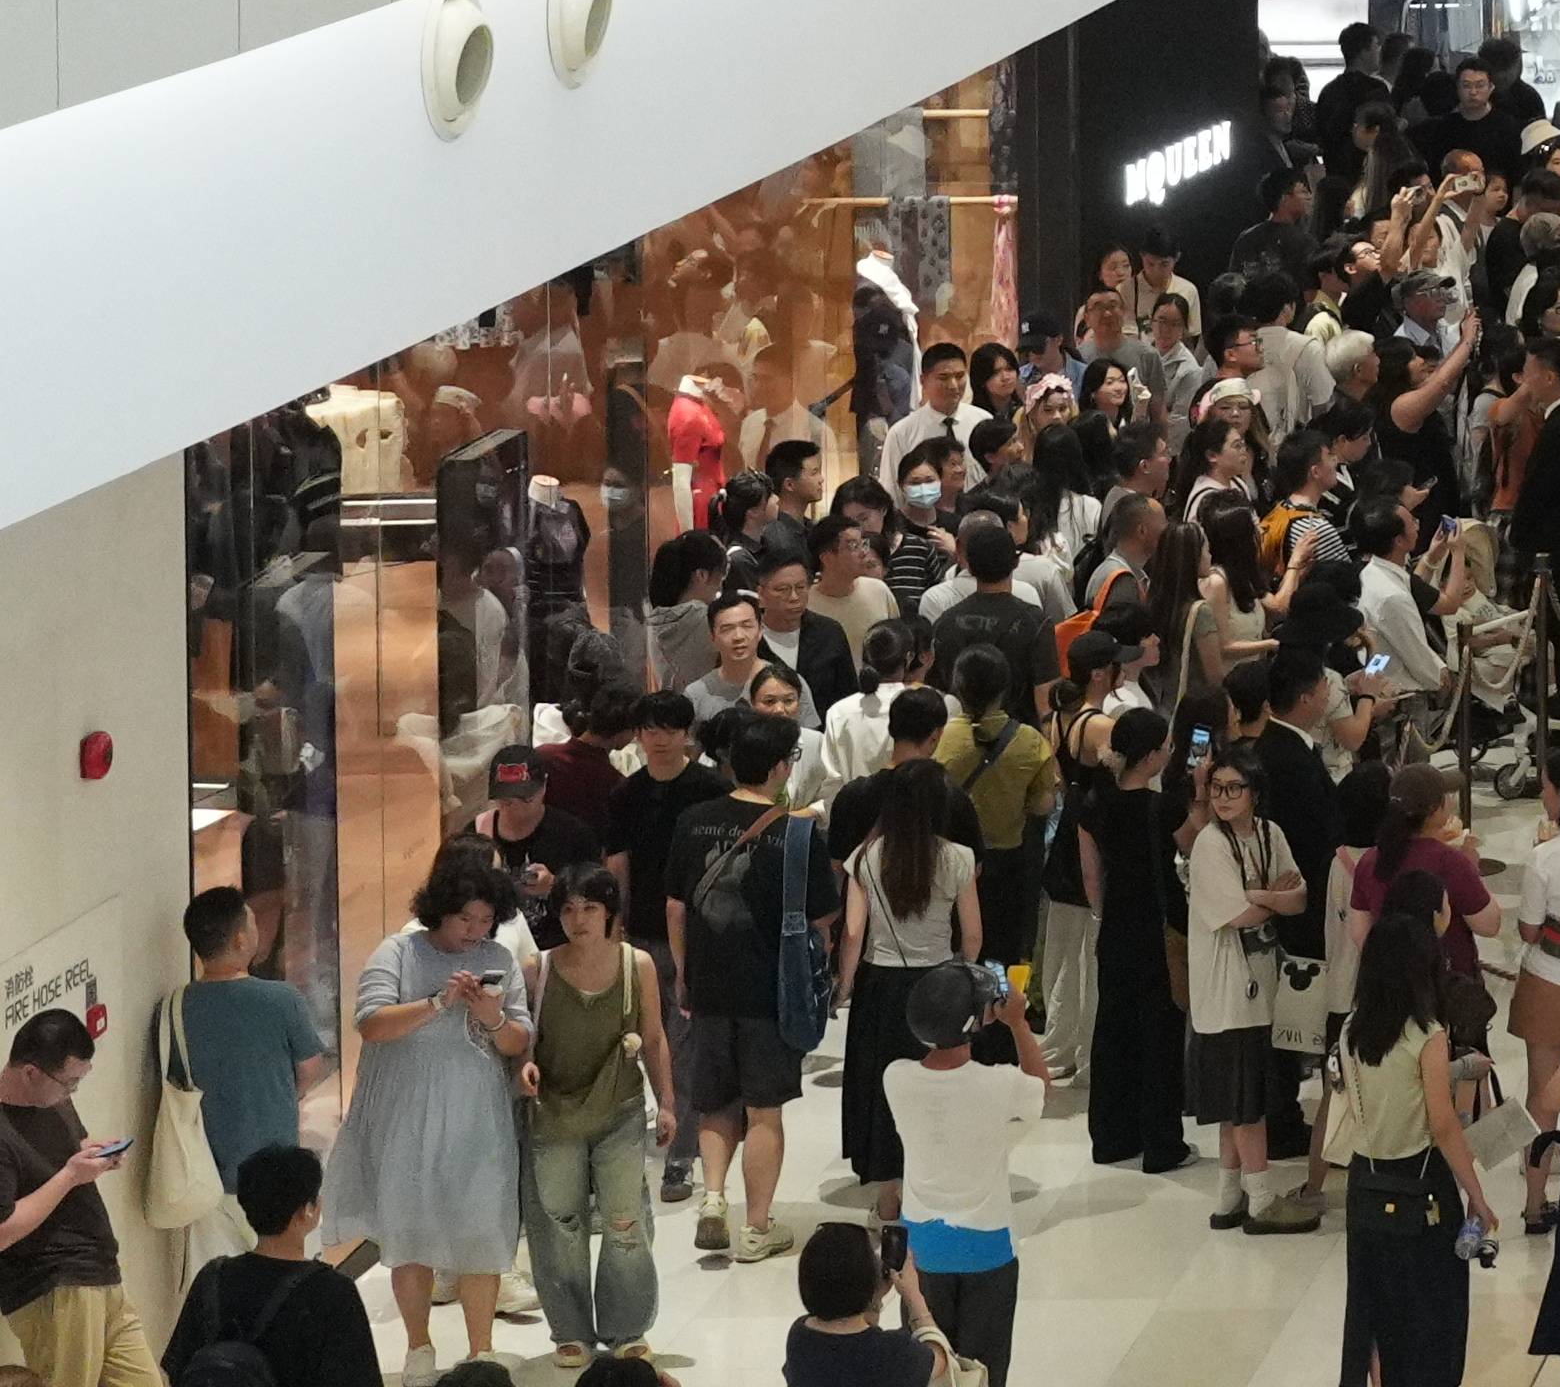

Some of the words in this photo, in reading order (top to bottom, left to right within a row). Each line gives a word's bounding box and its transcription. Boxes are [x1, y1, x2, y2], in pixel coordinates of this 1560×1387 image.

[5, 994, 29, 1030] FIRE
[32, 974, 62, 1014] HOSE
[65, 957, 94, 993] REEL
